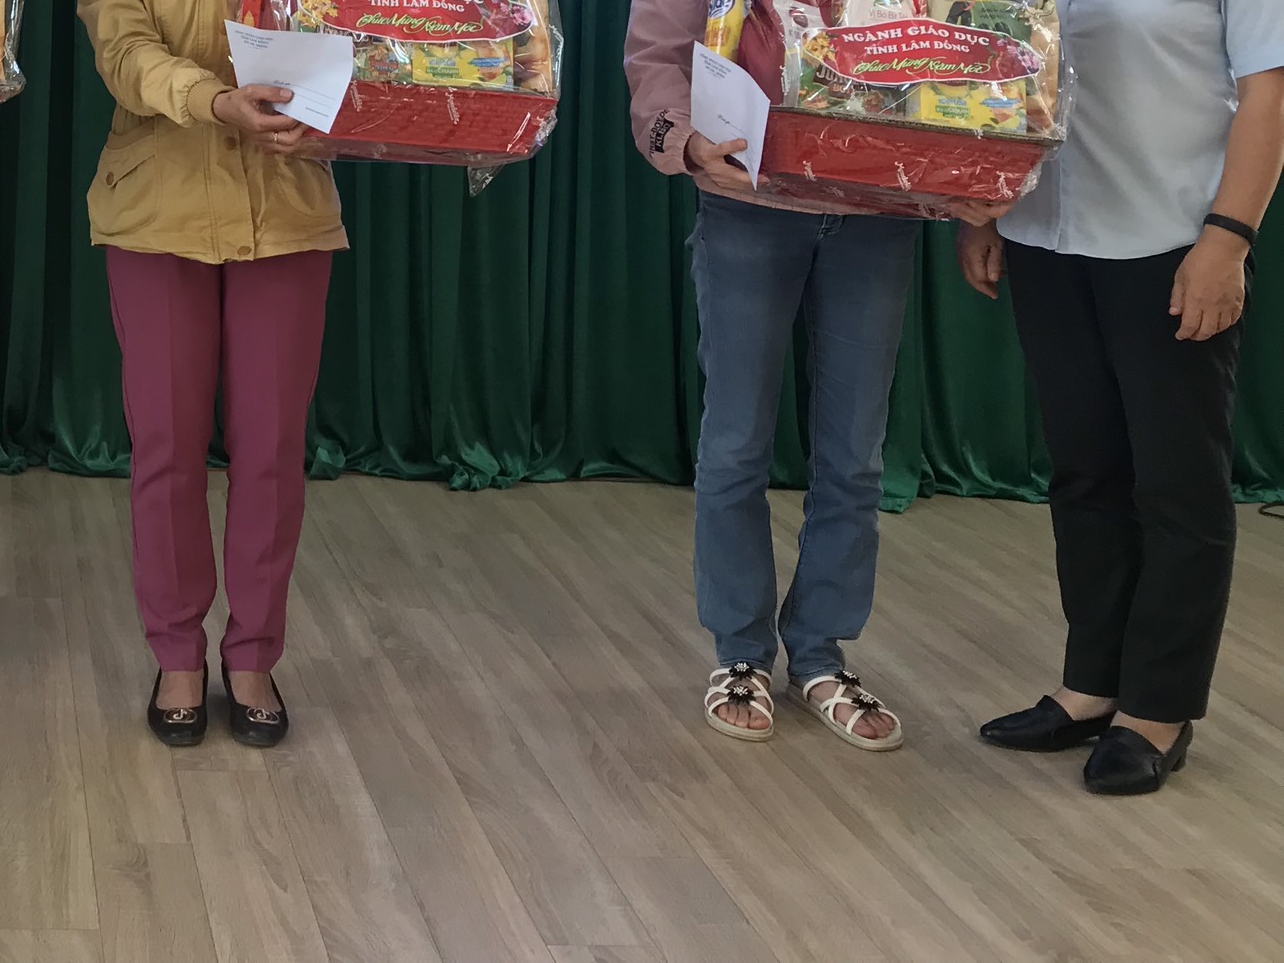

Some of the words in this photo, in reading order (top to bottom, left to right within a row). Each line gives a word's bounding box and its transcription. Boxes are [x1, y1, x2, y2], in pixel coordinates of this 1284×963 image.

[842, 27, 903, 43] NGÀNH
[907, 25, 950, 38] GIÁO
[954, 31, 990, 46] DỤC
